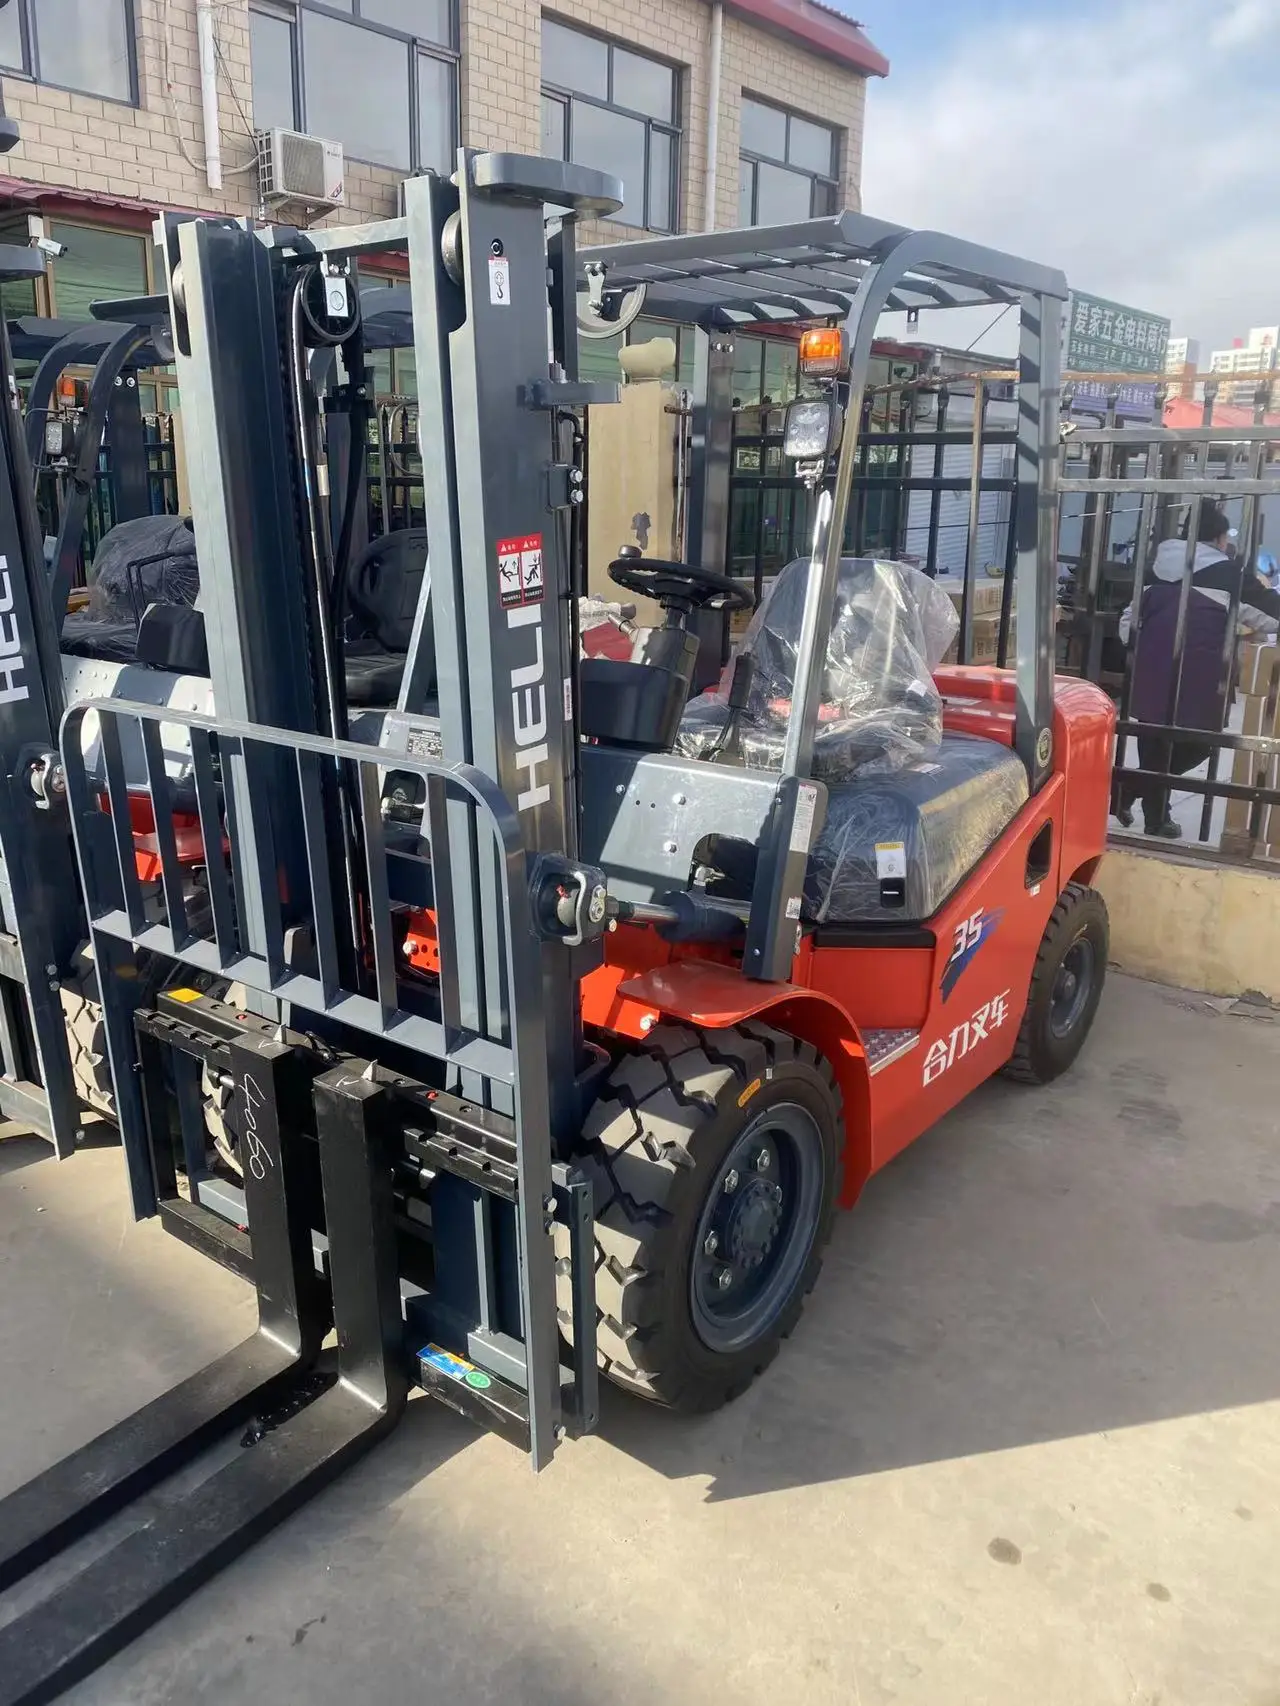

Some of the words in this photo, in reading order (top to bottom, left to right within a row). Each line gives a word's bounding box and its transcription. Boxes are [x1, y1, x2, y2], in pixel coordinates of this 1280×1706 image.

[507, 604, 551, 811] HELI
[950, 907, 985, 962] 35
[922, 988, 1011, 1088] 合力叉车
